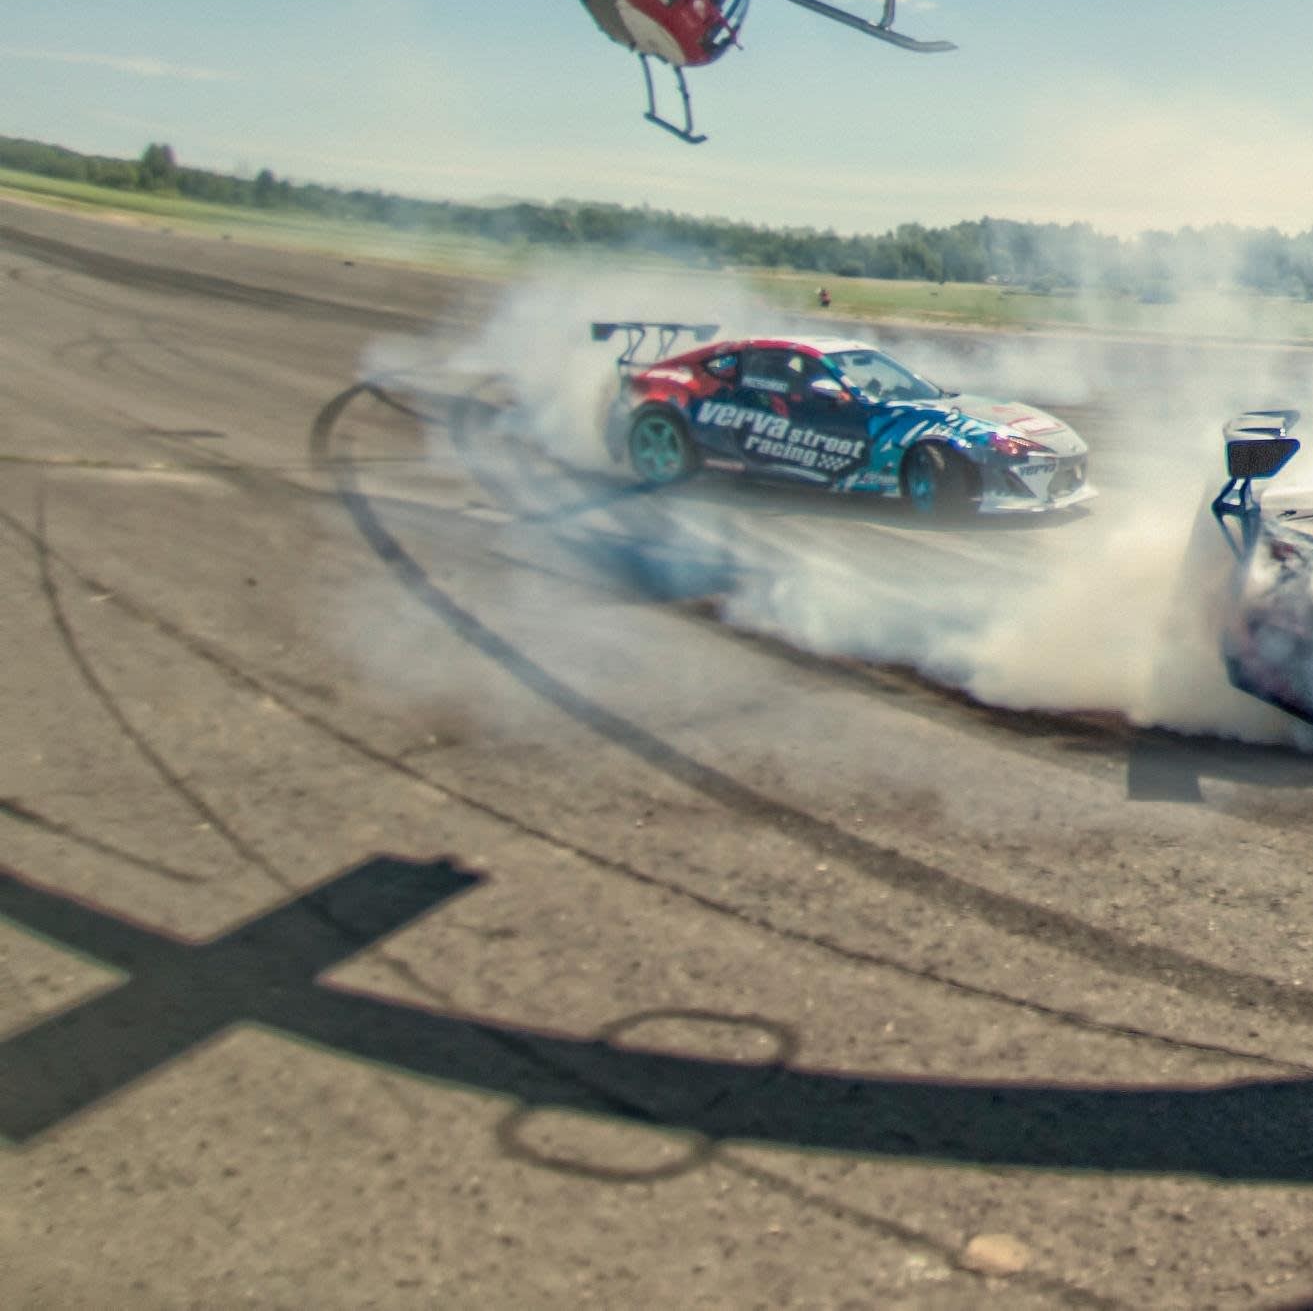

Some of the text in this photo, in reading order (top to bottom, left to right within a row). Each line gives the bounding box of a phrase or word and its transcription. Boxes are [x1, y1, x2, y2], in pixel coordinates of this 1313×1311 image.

[697, 399, 866, 460] verva street
[743, 435, 819, 469] racing
